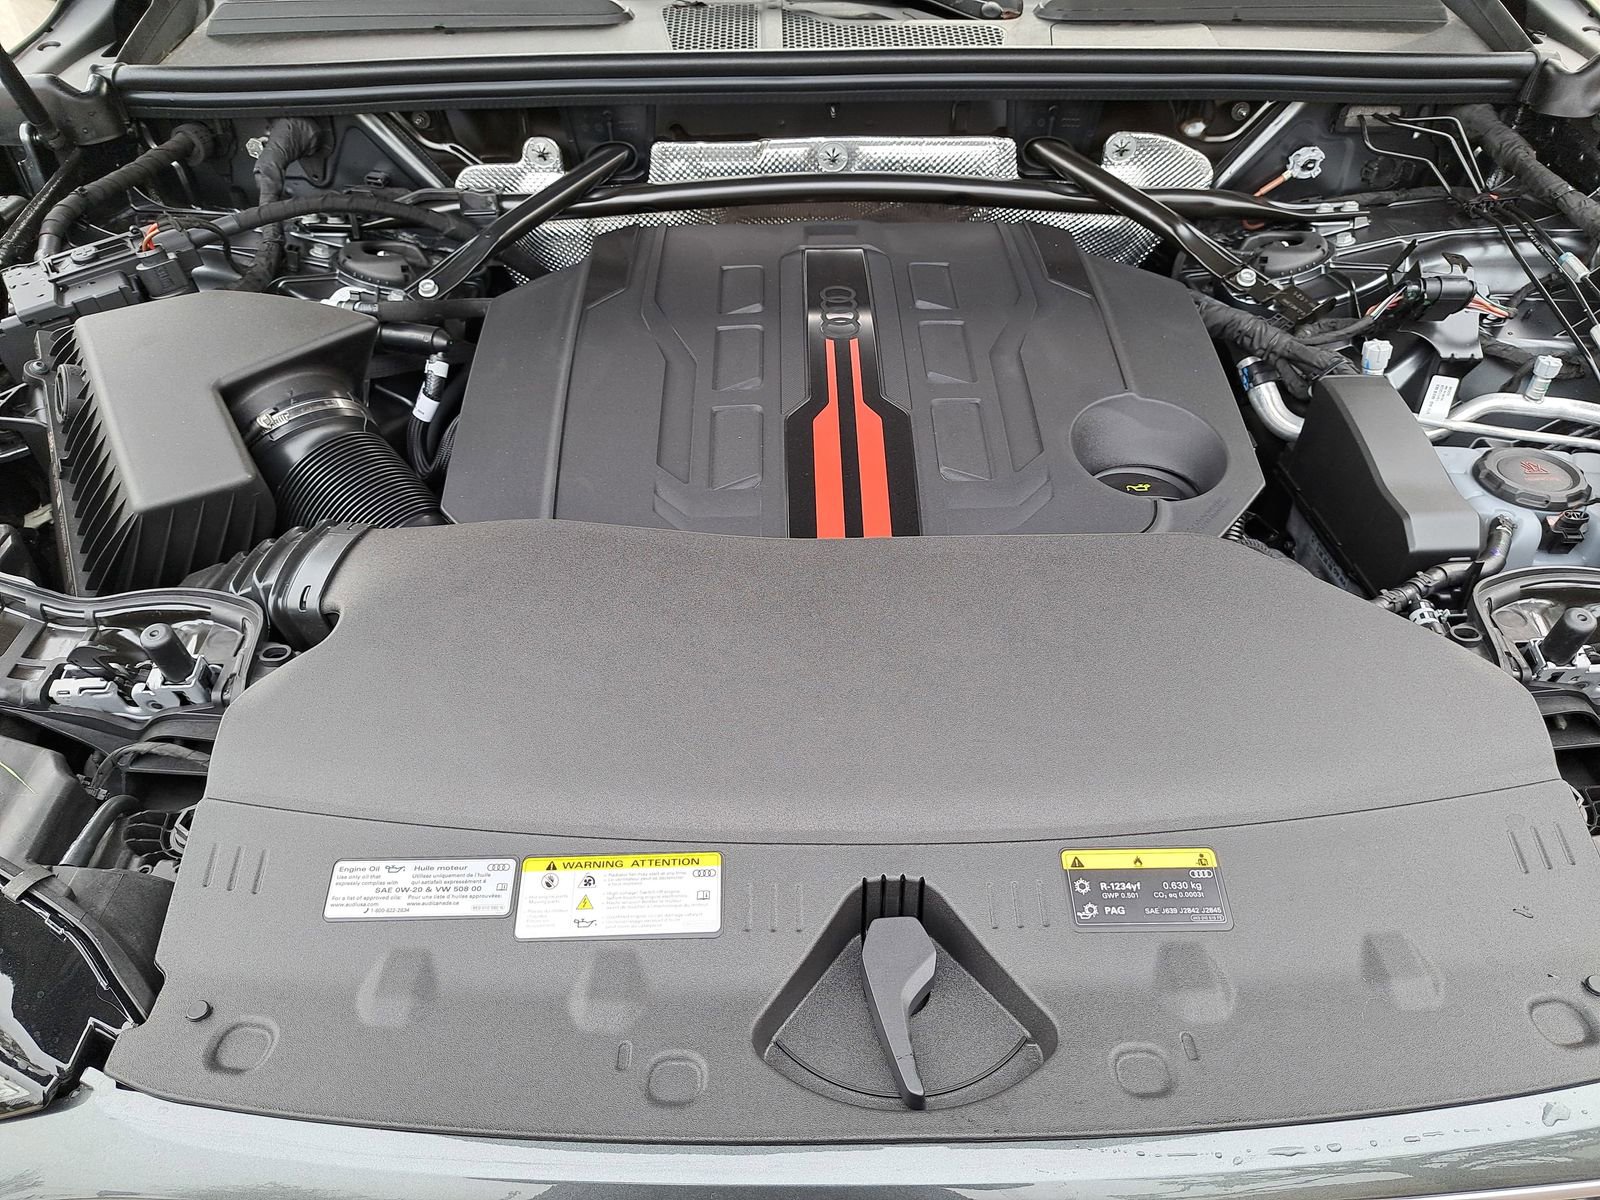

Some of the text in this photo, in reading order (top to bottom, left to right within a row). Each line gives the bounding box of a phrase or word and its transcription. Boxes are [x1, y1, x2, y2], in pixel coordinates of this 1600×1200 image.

[562, 858, 700, 869] WARNING ATTENTION
[1100, 881, 1141, 892] R-1234yf
[1162, 881, 1202, 891] 0.630 kg
[1104, 906, 1126, 915] PAG
[1201, 906, 1222, 914] J2845
